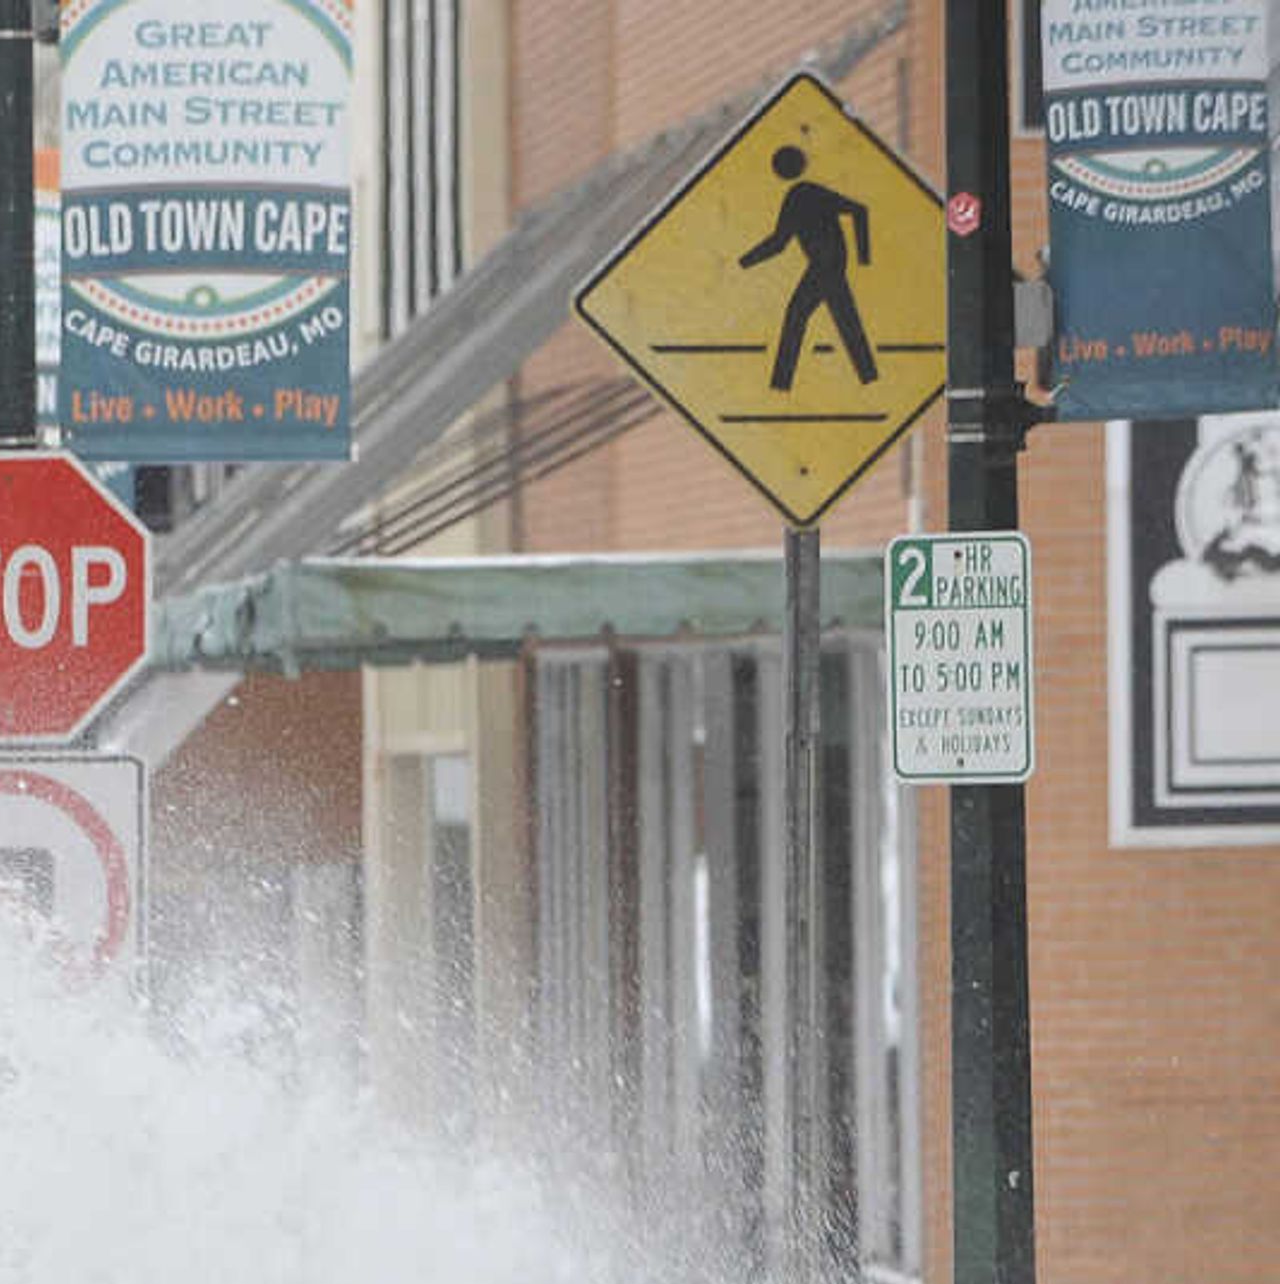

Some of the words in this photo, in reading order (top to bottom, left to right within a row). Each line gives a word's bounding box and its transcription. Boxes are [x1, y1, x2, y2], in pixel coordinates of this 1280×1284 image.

[135, 20, 272, 48] GREAT
[1050, 20, 1125, 45] MAIN
[1137, 16, 1260, 37] STREET
[100, 59, 309, 88] AMERICAN
[1061, 48, 1244, 74] COMMUNITY
[67, 99, 168, 130] MAIN
[185, 96, 344, 127] STREET
[1048, 98, 1100, 142] OLD
[1106, 94, 1186, 135] TOWN
[1193, 91, 1266, 132] CAPE
[82, 140, 325, 168] COMMUNITY
[1050, 181, 1101, 215] CAPE
[64, 203, 132, 258] OLD
[140, 200, 244, 251] TOWN
[254, 201, 349, 254] CAPE
[64, 309, 129, 356] CAPE
[135, 337, 298, 371] GIRARDEAU,
[300, 306, 343, 345] MO
[1059, 337, 1107, 363] Live
[1132, 331, 1194, 357] Work
[1219, 326, 1272, 357] Play
[71, 389, 133, 423] Live
[165, 385, 243, 422] Work
[274, 388, 339, 430] Play
[898, 548, 928, 605] 2
[965, 546, 992, 572] HR
[937, 576, 1023, 607] PARKING
[915, 621, 960, 650] 9:00
[975, 620, 1003, 649] AM
[901, 664, 925, 692] TO
[937, 662, 981, 691] 5:00
[992, 662, 1020, 690] PM
[900, 708, 949, 728] EXCEPT
[958, 708, 1022, 728] SUNDAYS
[941, 735, 1011, 753] HOLIDAYS
